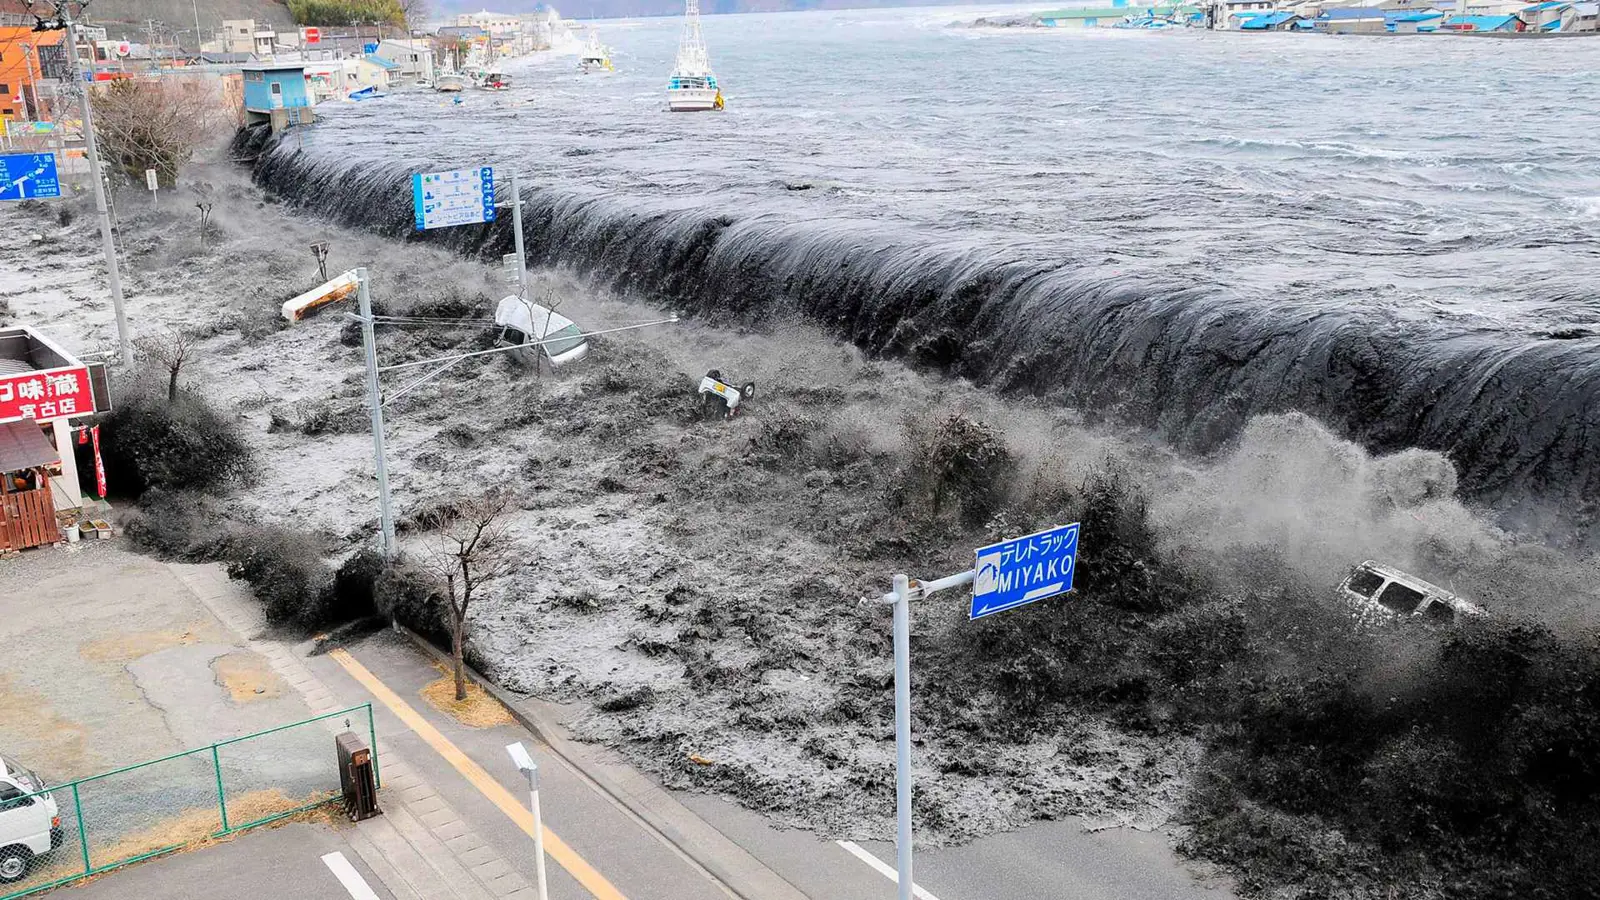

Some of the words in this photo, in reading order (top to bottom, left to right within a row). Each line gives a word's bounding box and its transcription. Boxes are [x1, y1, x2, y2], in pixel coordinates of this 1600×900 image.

[18, 398, 76, 420] 宮古店
[1001, 527, 1077, 566] テレトラック
[997, 555, 1073, 594] MIYAKO
